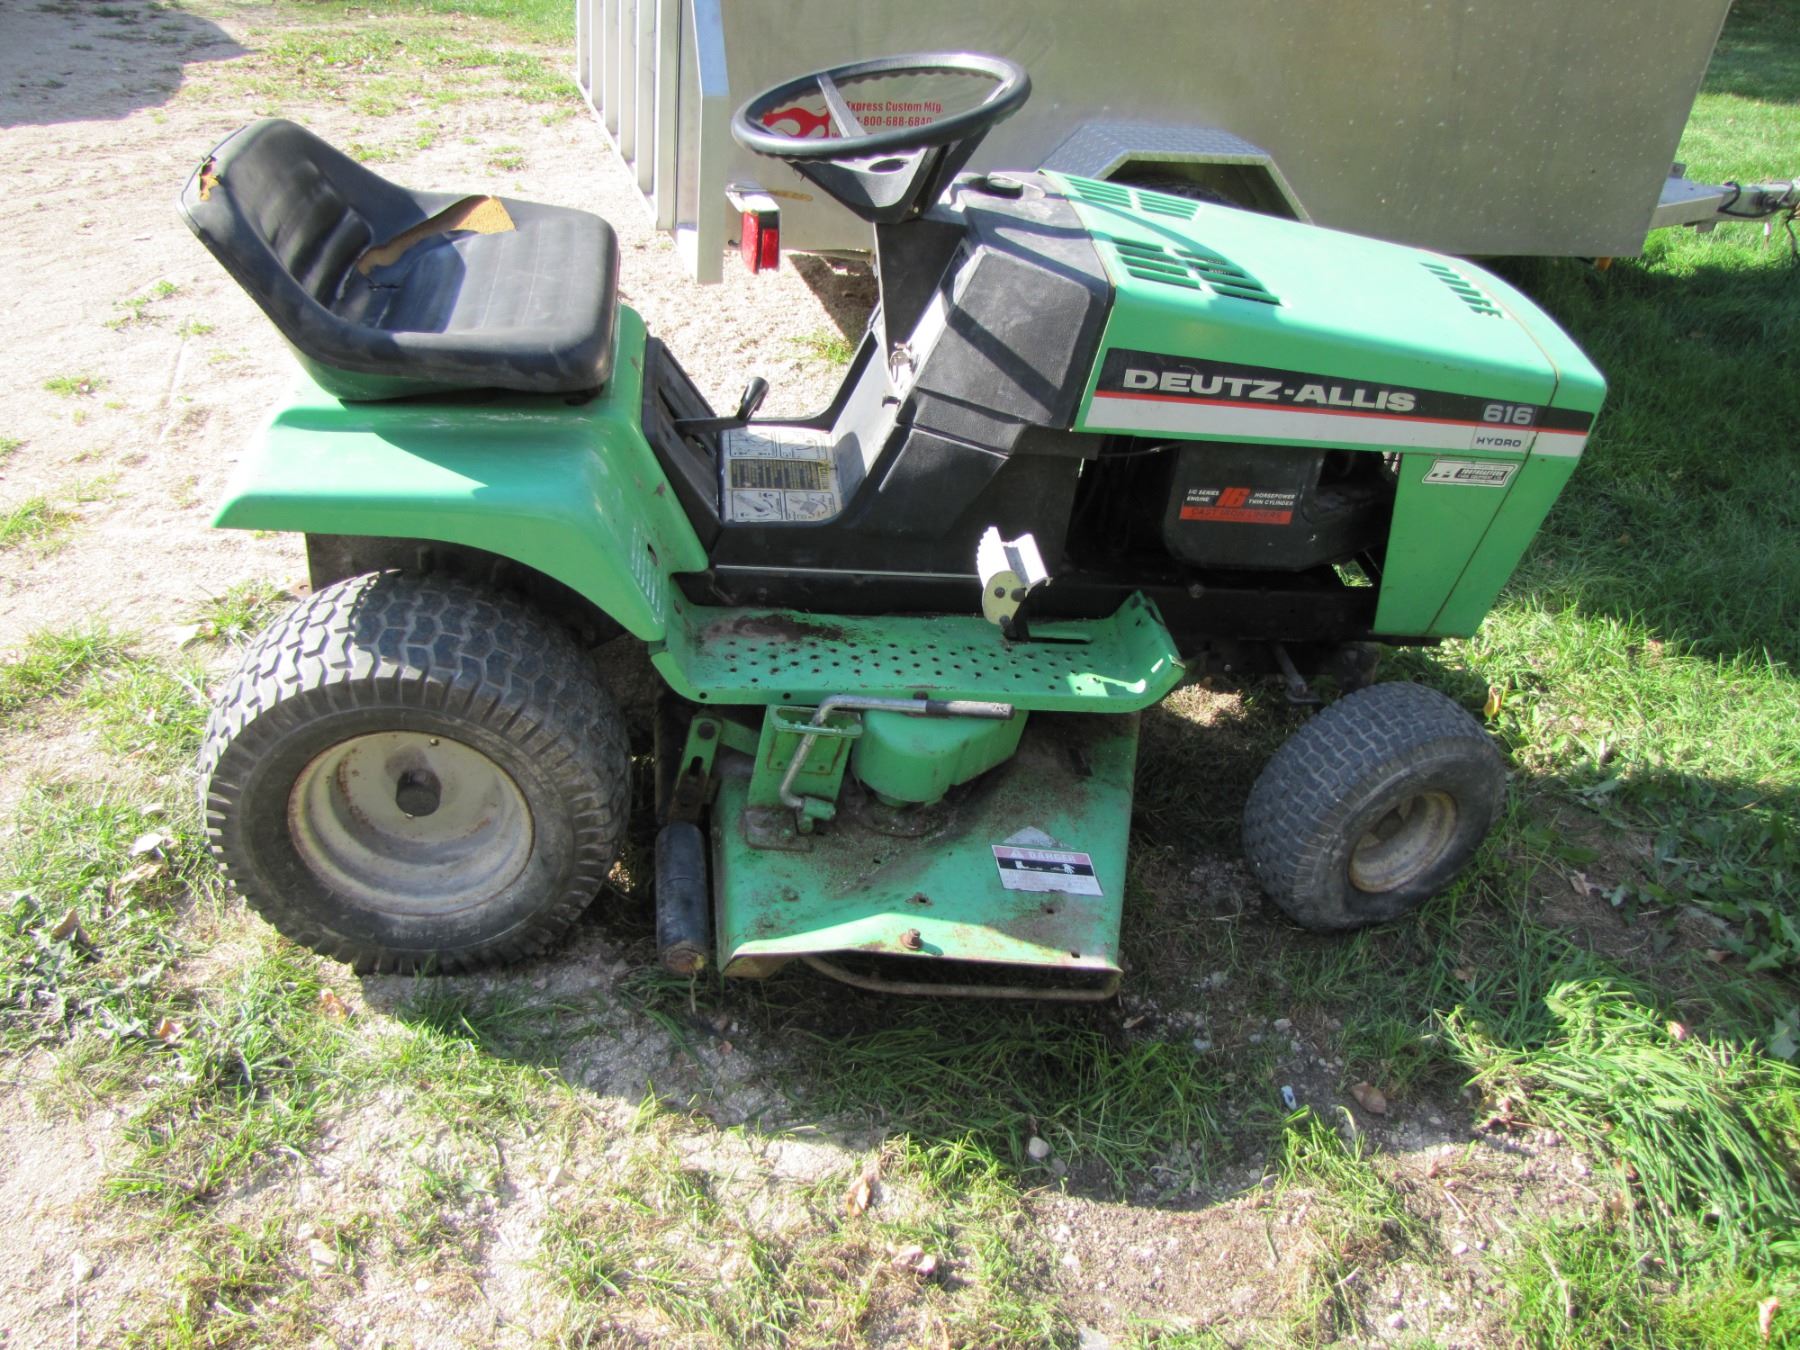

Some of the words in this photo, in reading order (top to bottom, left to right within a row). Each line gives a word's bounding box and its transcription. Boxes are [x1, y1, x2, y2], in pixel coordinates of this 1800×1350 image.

[886, 101, 922, 112] Custom
[924, 101, 944, 114] Mfg.
[1123, 368, 1416, 412] DEUTZ-ALLIS
[1483, 404, 1533, 425] 616
[1476, 437, 1522, 448] HYDRO
[1215, 487, 1250, 507] 16
[1191, 508, 1219, 517] CAST
[1028, 851, 1076, 863] DANGER
